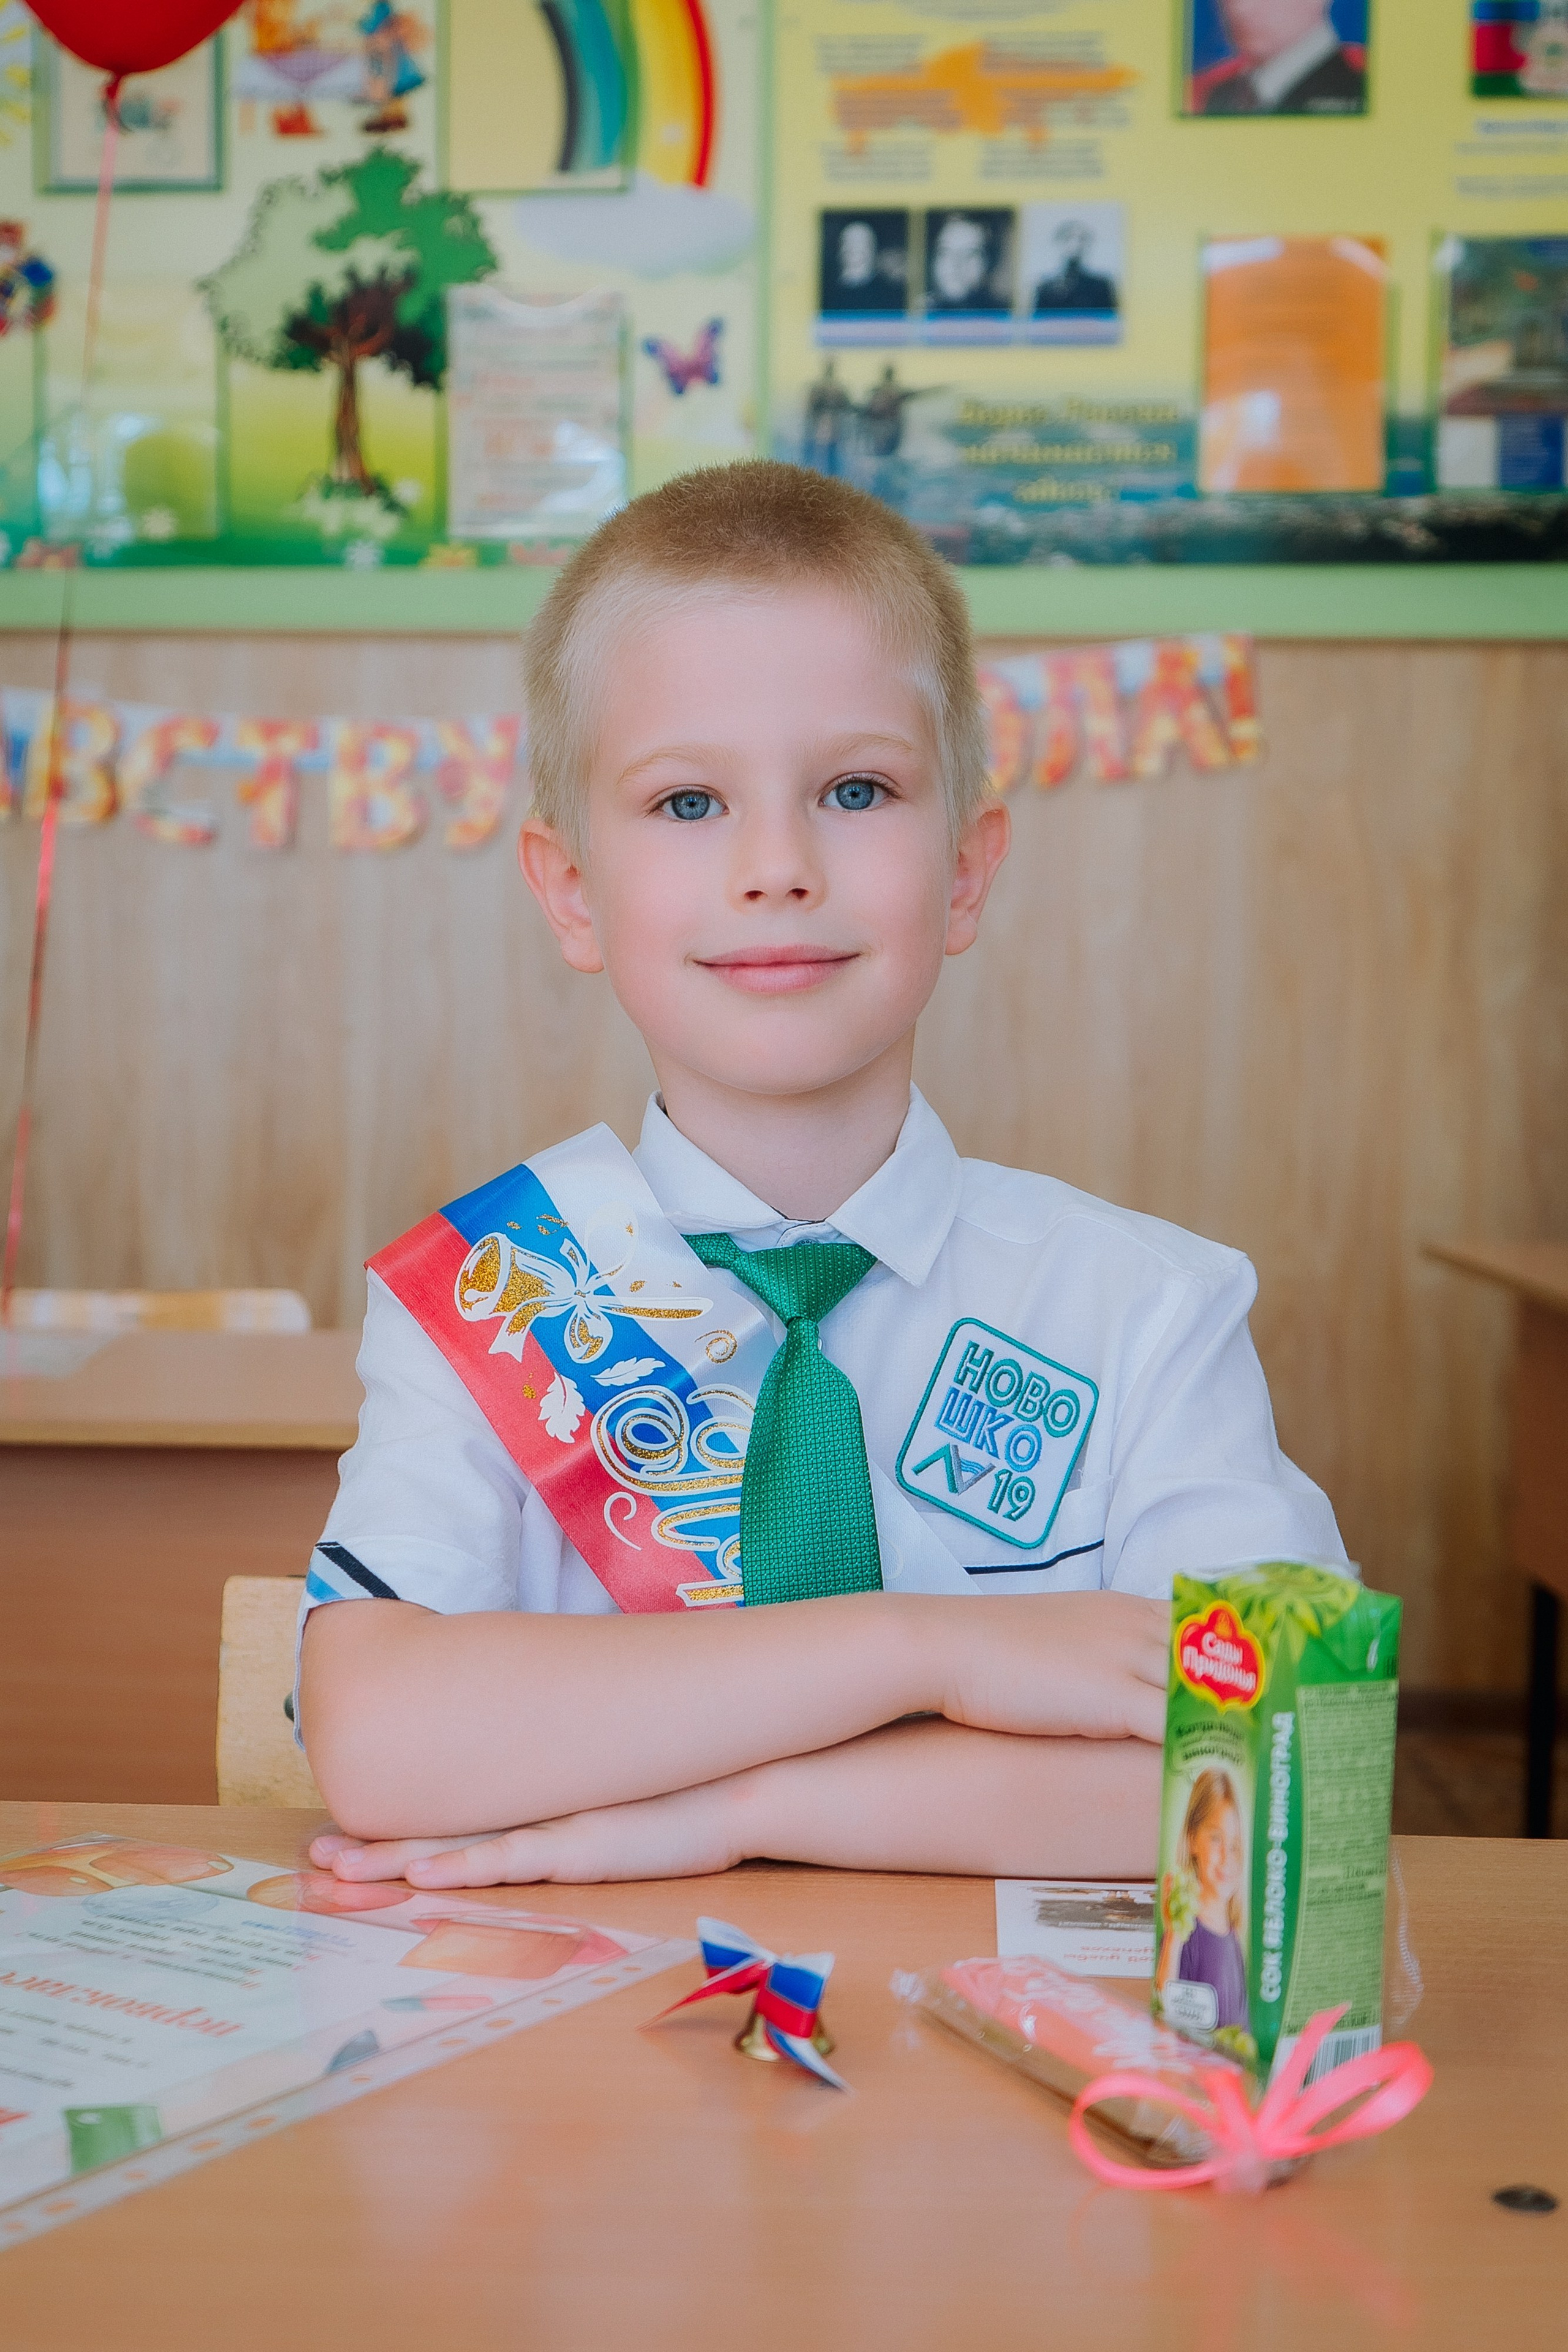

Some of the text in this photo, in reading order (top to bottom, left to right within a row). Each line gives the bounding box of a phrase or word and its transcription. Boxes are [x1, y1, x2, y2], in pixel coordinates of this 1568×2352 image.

[0, 698, 522, 853] ВСТВУ
[935, 1386, 1042, 1472] ШКО
[954, 1340, 1080, 1438] НОВО
[987, 1469, 1035, 1521] 19
[1261, 1951, 1283, 2002] СОК
